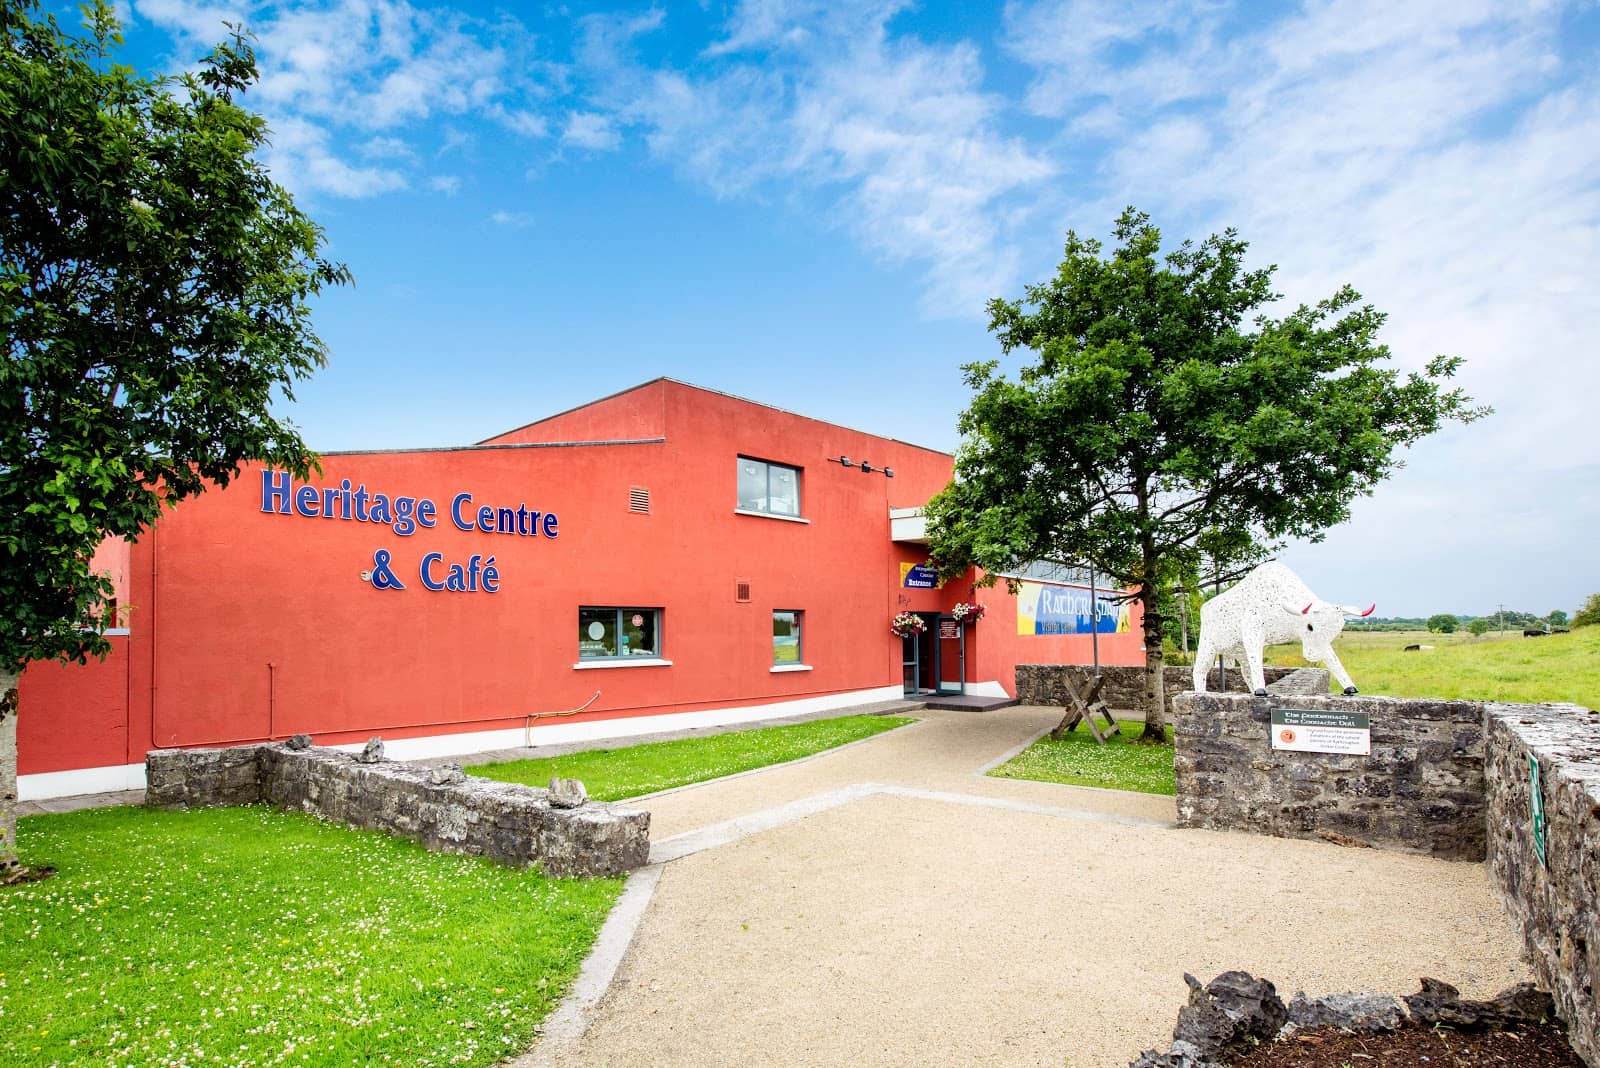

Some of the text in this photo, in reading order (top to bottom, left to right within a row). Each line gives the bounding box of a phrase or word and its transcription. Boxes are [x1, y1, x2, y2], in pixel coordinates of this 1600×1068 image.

[260, 468, 559, 539] Heritage Centre
[370, 548, 500, 593] & Café
